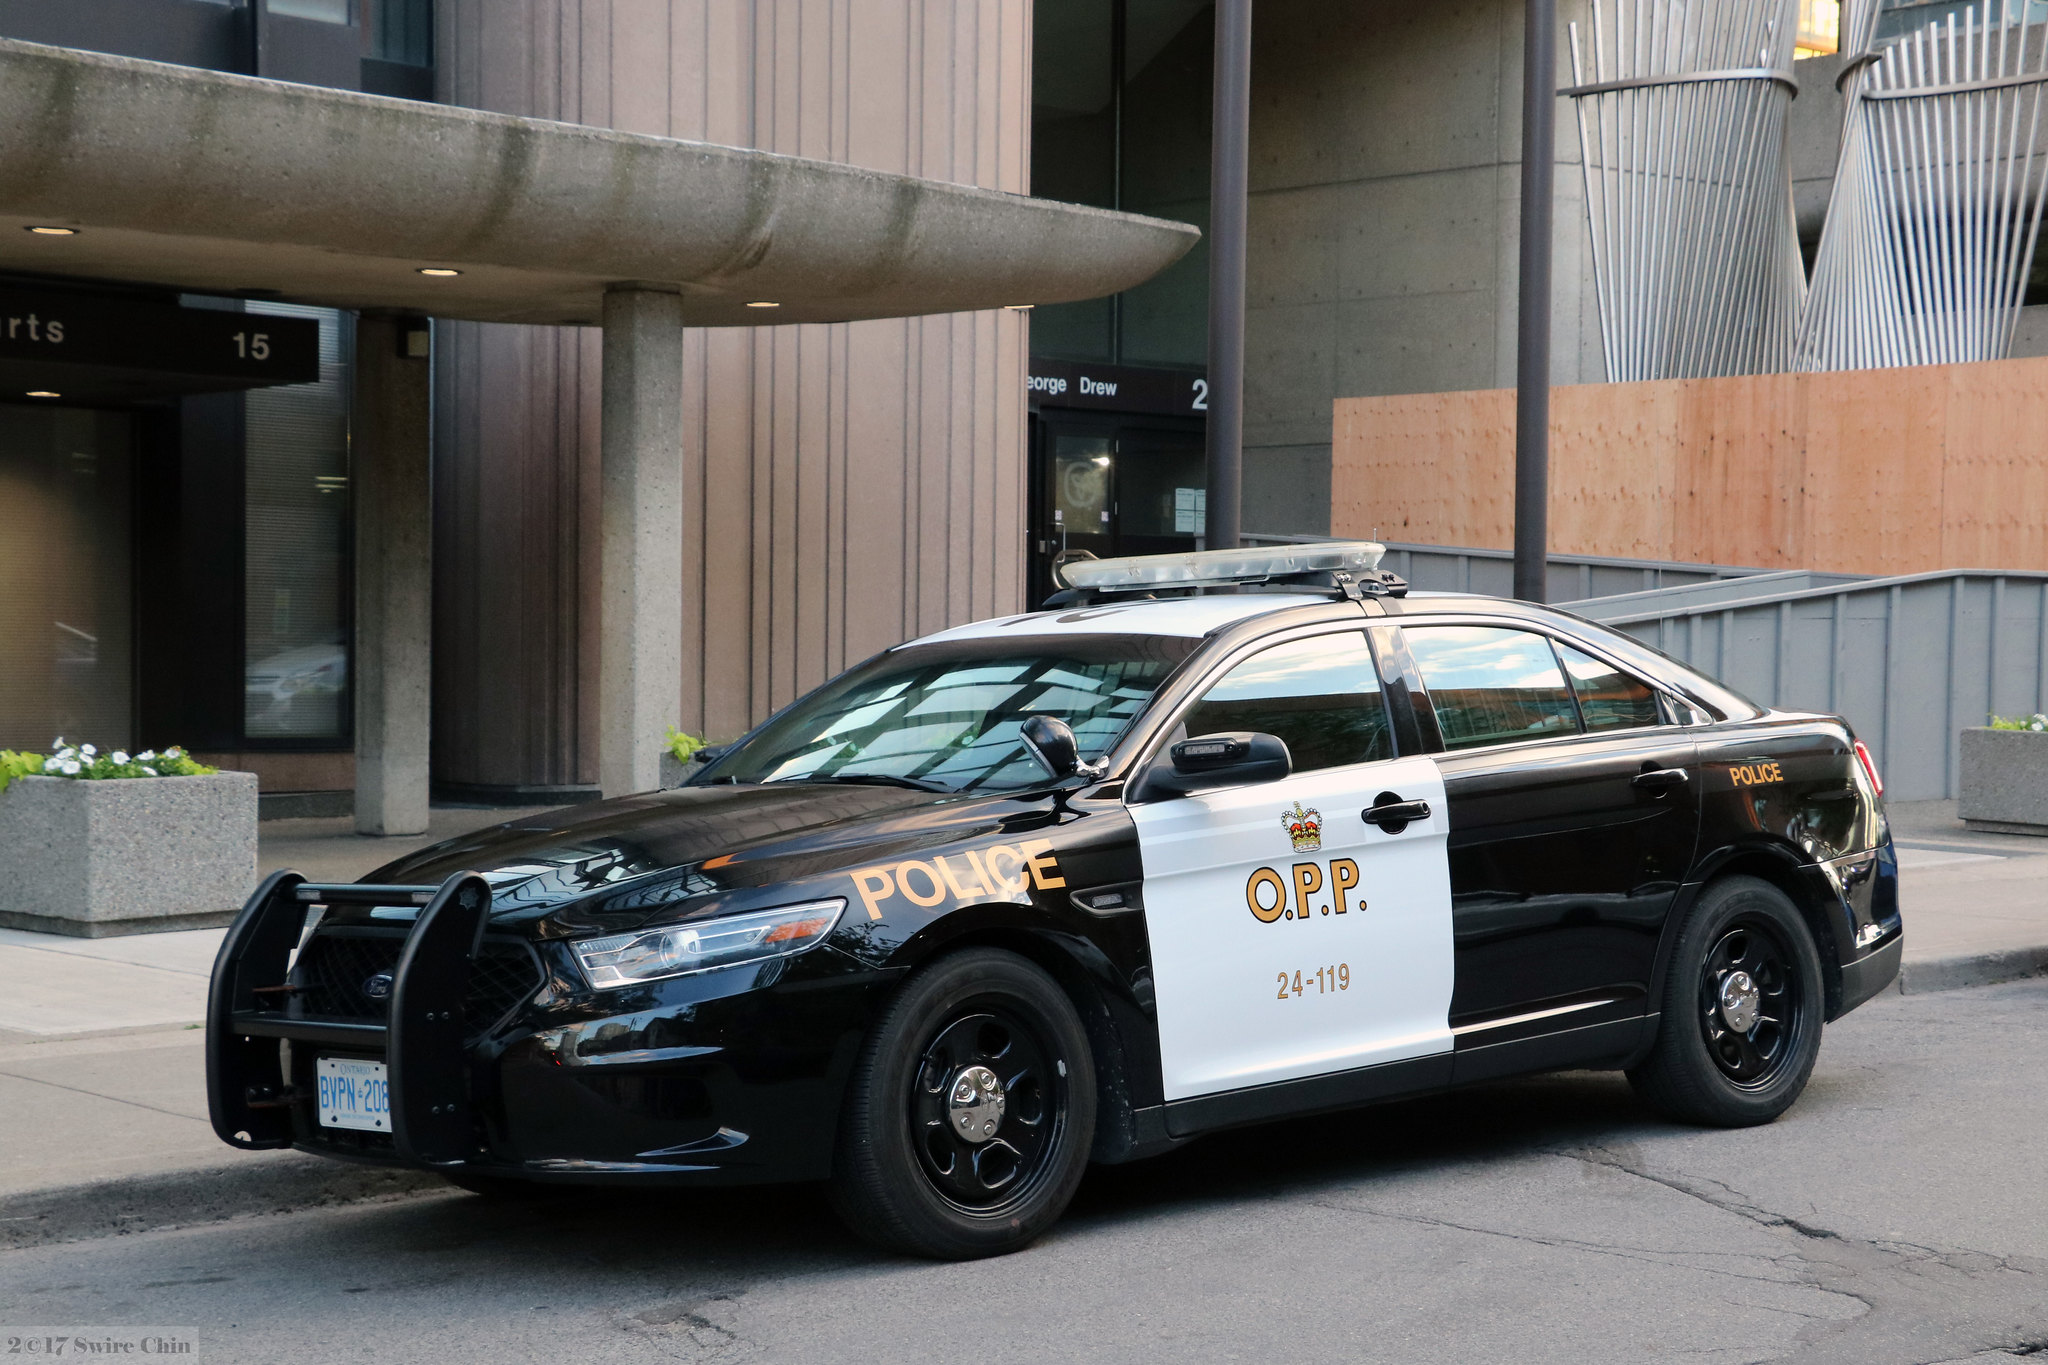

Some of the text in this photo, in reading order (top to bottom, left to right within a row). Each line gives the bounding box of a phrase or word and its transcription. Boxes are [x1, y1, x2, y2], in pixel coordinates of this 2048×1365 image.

[0, 314, 64, 343] rts
[233, 333, 270, 360] 15
[1080, 376, 1117, 396] Drew
[1192, 379, 1208, 410] 2
[1729, 762, 1784, 787] POLICE
[850, 838, 1066, 920] POLICE
[1246, 858, 1367, 923] O.P.P.
[1277, 963, 1350, 999] 24-119
[320, 1075, 356, 1110] BVPN
